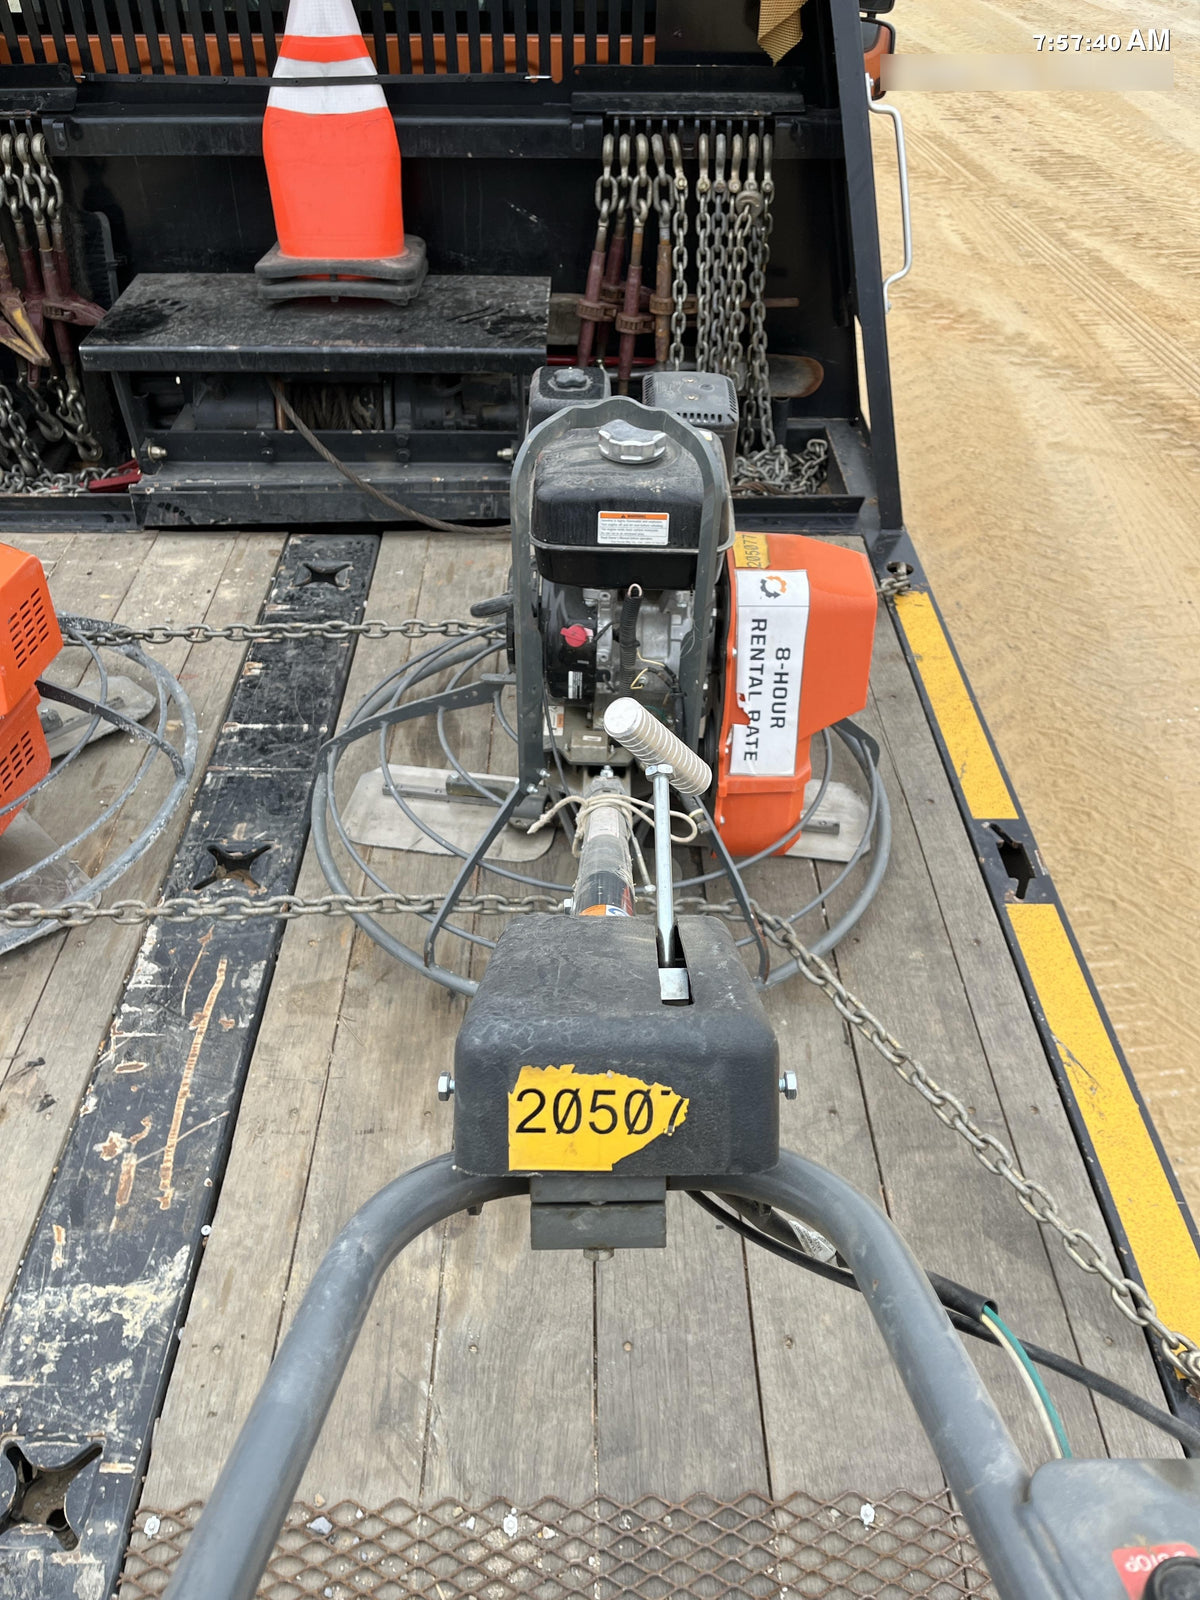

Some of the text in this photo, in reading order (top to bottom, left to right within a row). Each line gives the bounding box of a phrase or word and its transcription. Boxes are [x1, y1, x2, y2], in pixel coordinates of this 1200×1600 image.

[741, 534, 762, 568] 205077
[743, 618, 768, 762] RENTAL RATE
[769, 647, 792, 730] 8-HOUR
